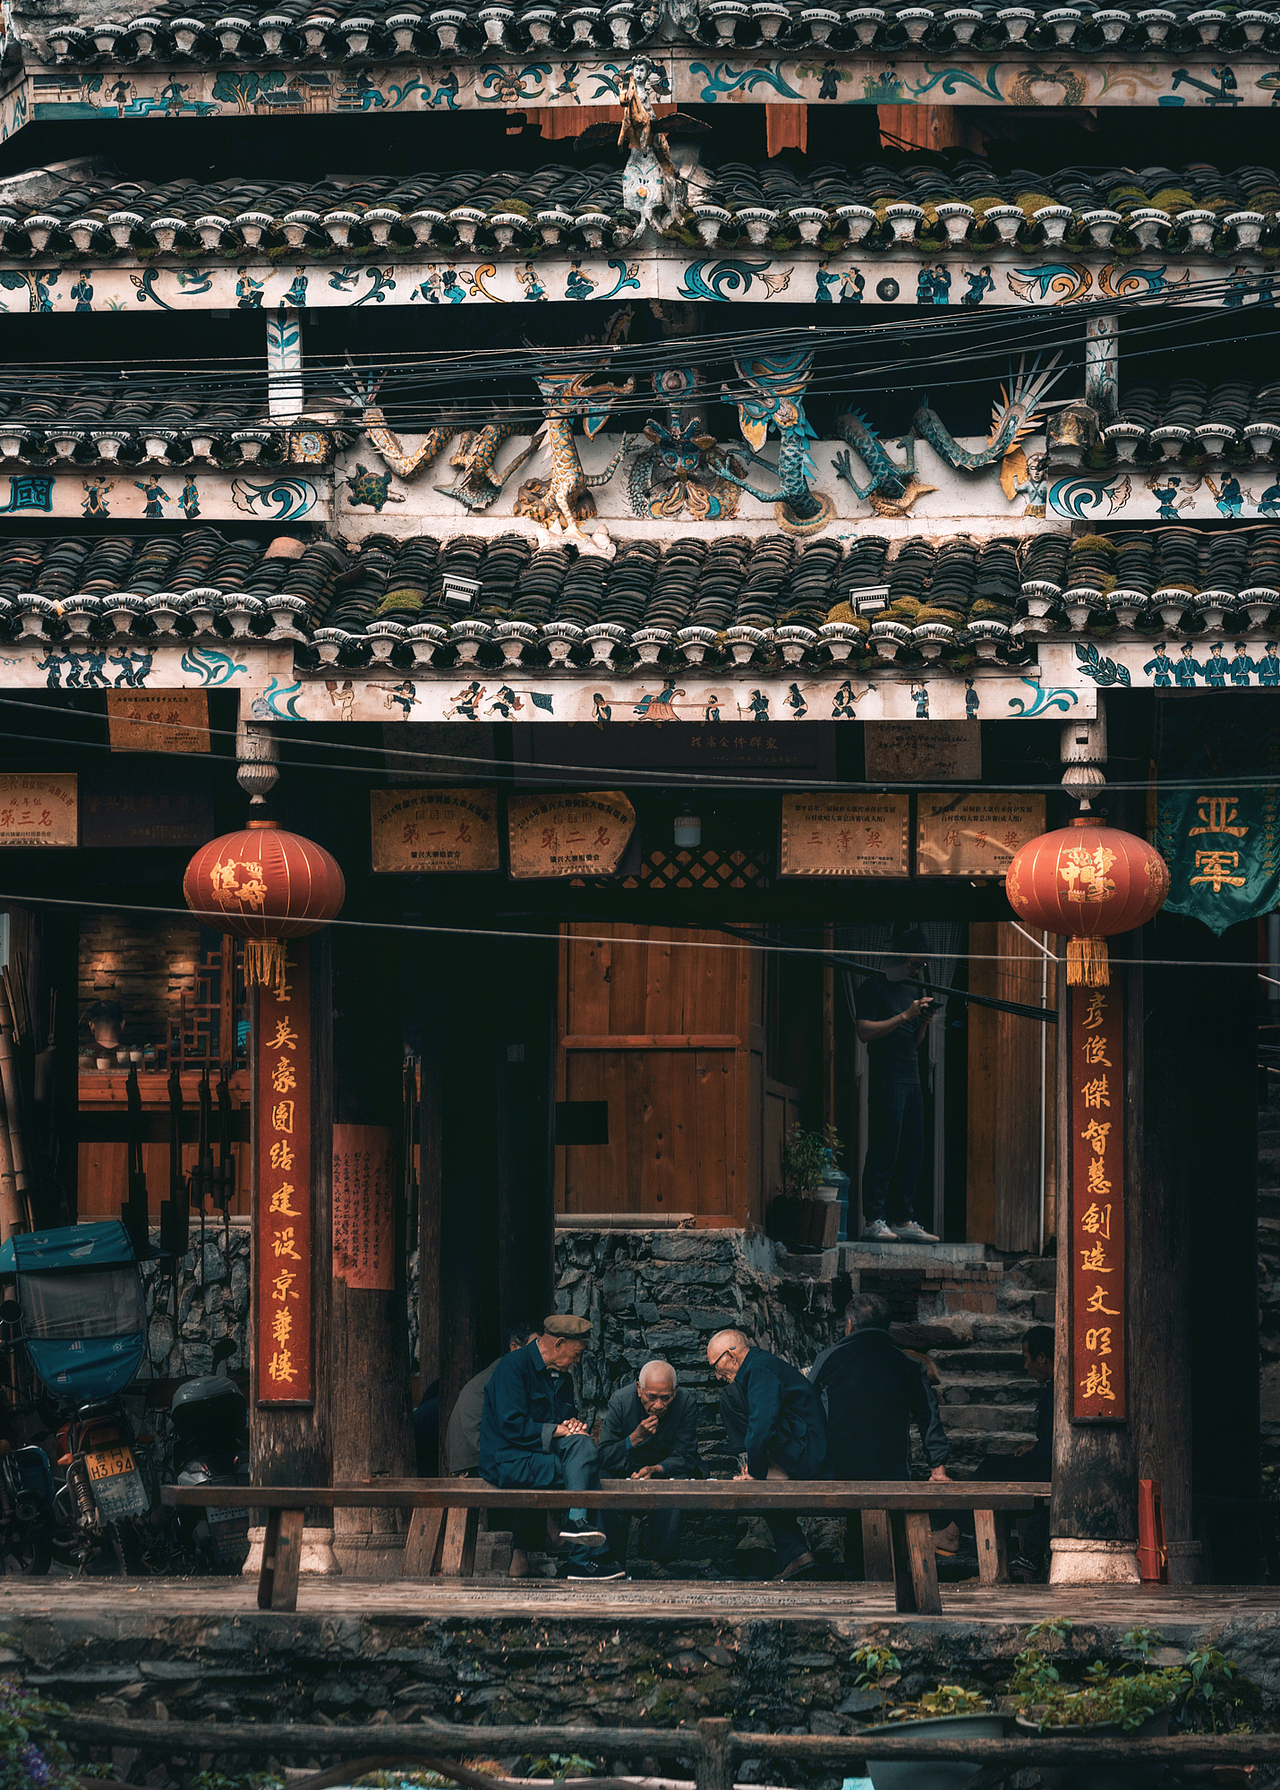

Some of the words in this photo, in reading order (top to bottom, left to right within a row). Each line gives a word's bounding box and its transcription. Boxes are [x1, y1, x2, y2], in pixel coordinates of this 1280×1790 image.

[0, 809, 53, 828] 第三名
[401, 822, 473, 845] 第一名
[540, 825, 611, 849] 第二名
[807, 829, 883, 849] 三等奖
[943, 830, 1020, 848] 优秀奖
[1188, 795, 1250, 893] 亚军
[91, 1458, 133, 1479] H3194
